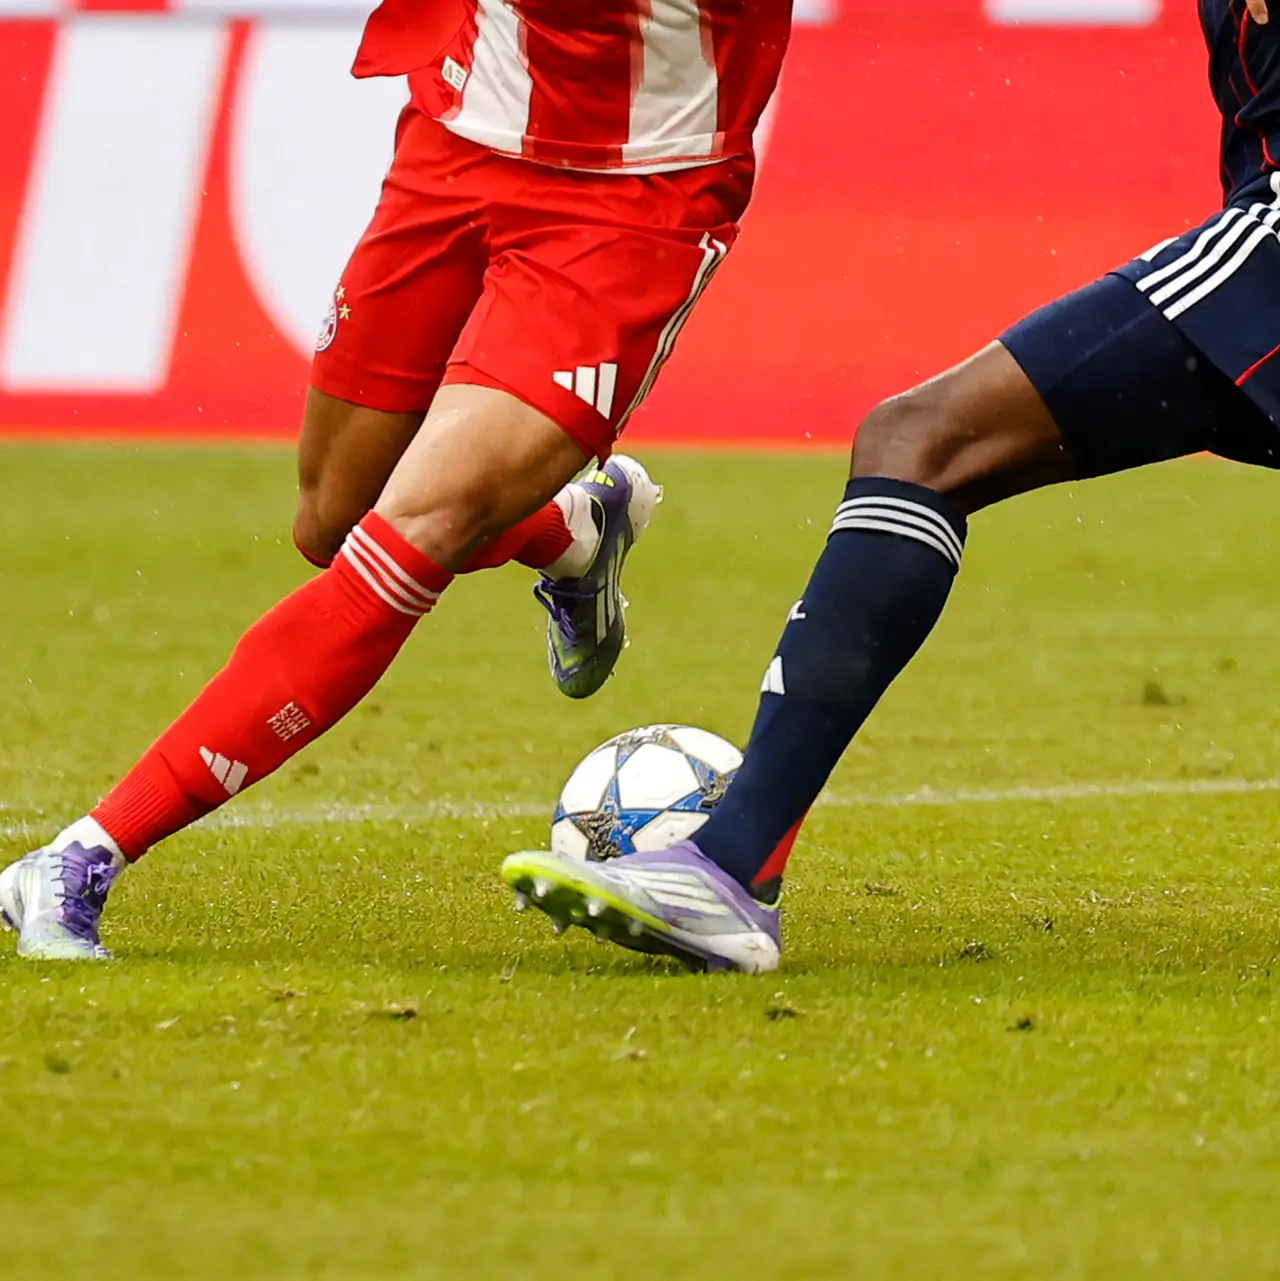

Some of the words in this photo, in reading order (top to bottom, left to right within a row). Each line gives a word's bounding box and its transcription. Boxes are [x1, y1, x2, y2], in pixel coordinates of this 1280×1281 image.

[266, 715, 292, 742] MIA
[275, 709, 303, 736] SAN
[283, 701, 311, 729] MIA
